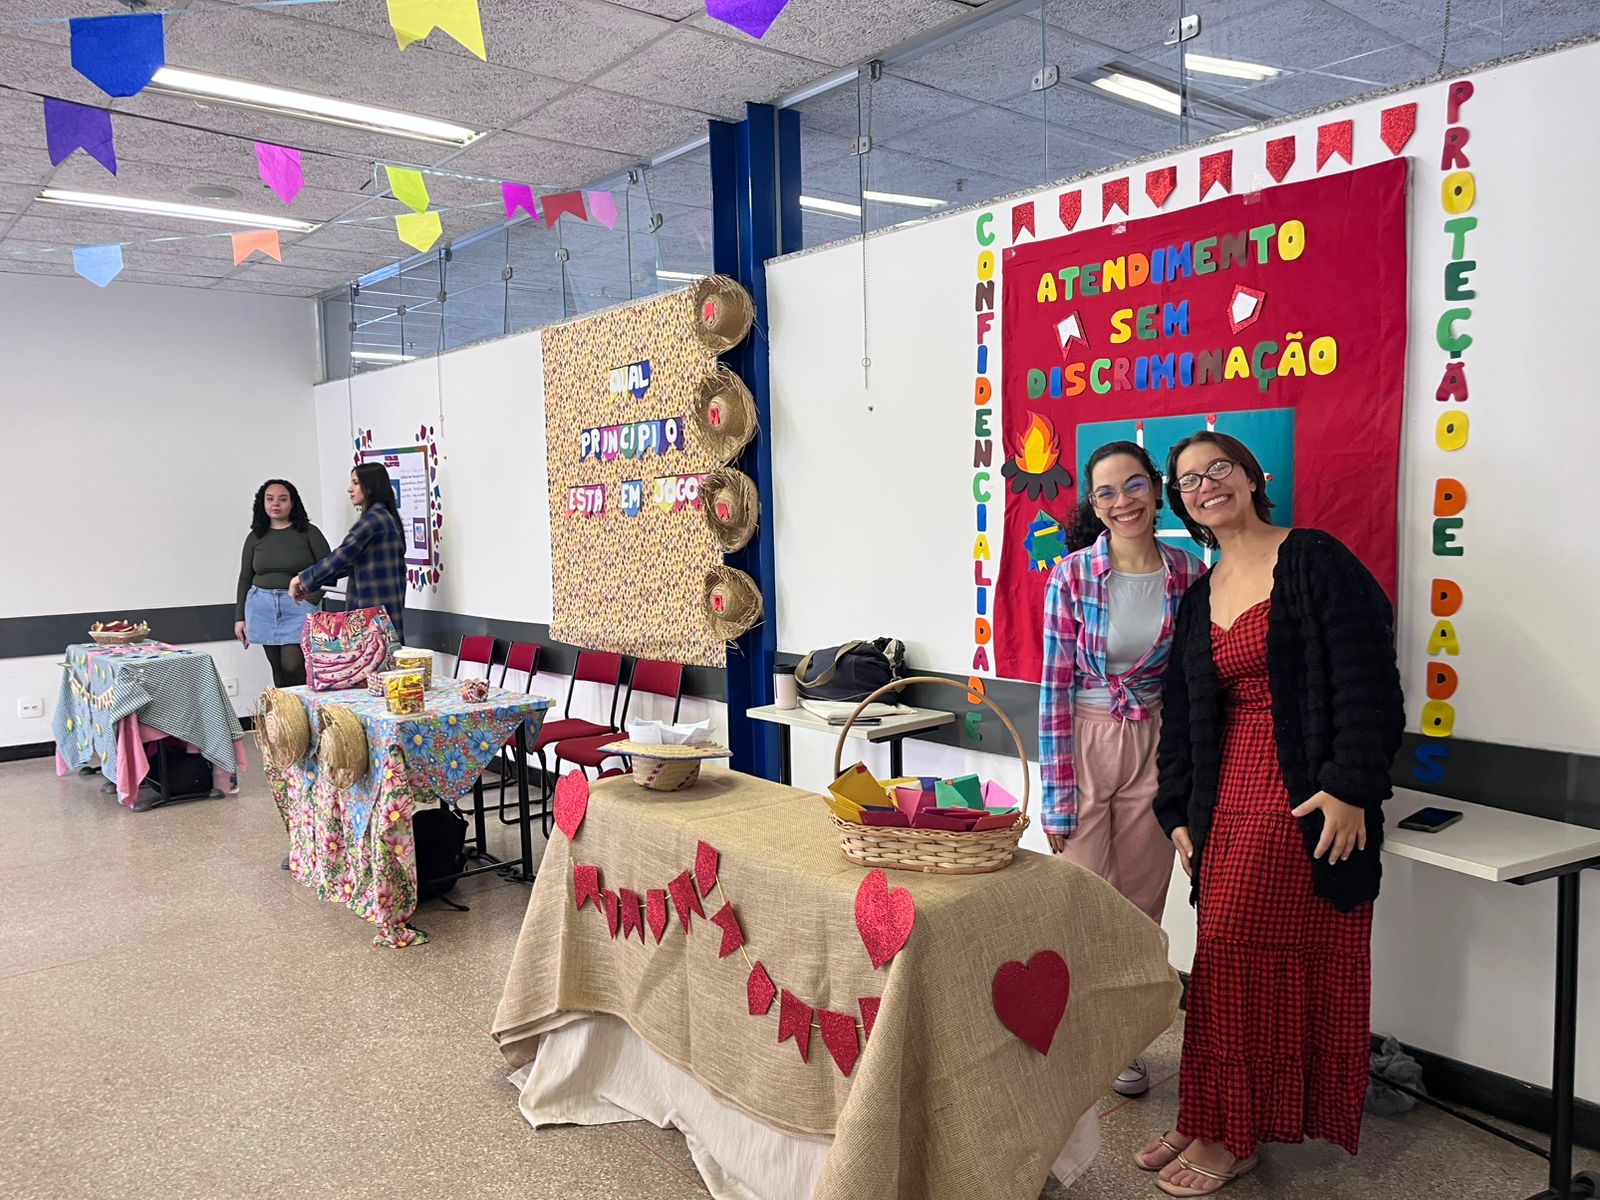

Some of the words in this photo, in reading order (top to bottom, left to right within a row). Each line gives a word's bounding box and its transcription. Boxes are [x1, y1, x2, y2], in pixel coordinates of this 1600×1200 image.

[1037, 219, 1306, 303] ATENDIMENTO
[1435, 80, 1478, 452] PROTEÇÃO
[1110, 301, 1190, 344] SEM
[609, 364, 649, 394] QUAL
[1026, 331, 1339, 399] DISCRIMINAÇÃO
[569, 485, 603, 513] ESTÁ
[621, 483, 641, 509] EM
[655, 476, 699, 504] JOGO
[964, 212, 996, 742] CONFIDENCIALIDADE
[1432, 478, 1467, 557] DE
[1411, 579, 1463, 783] DADOS
